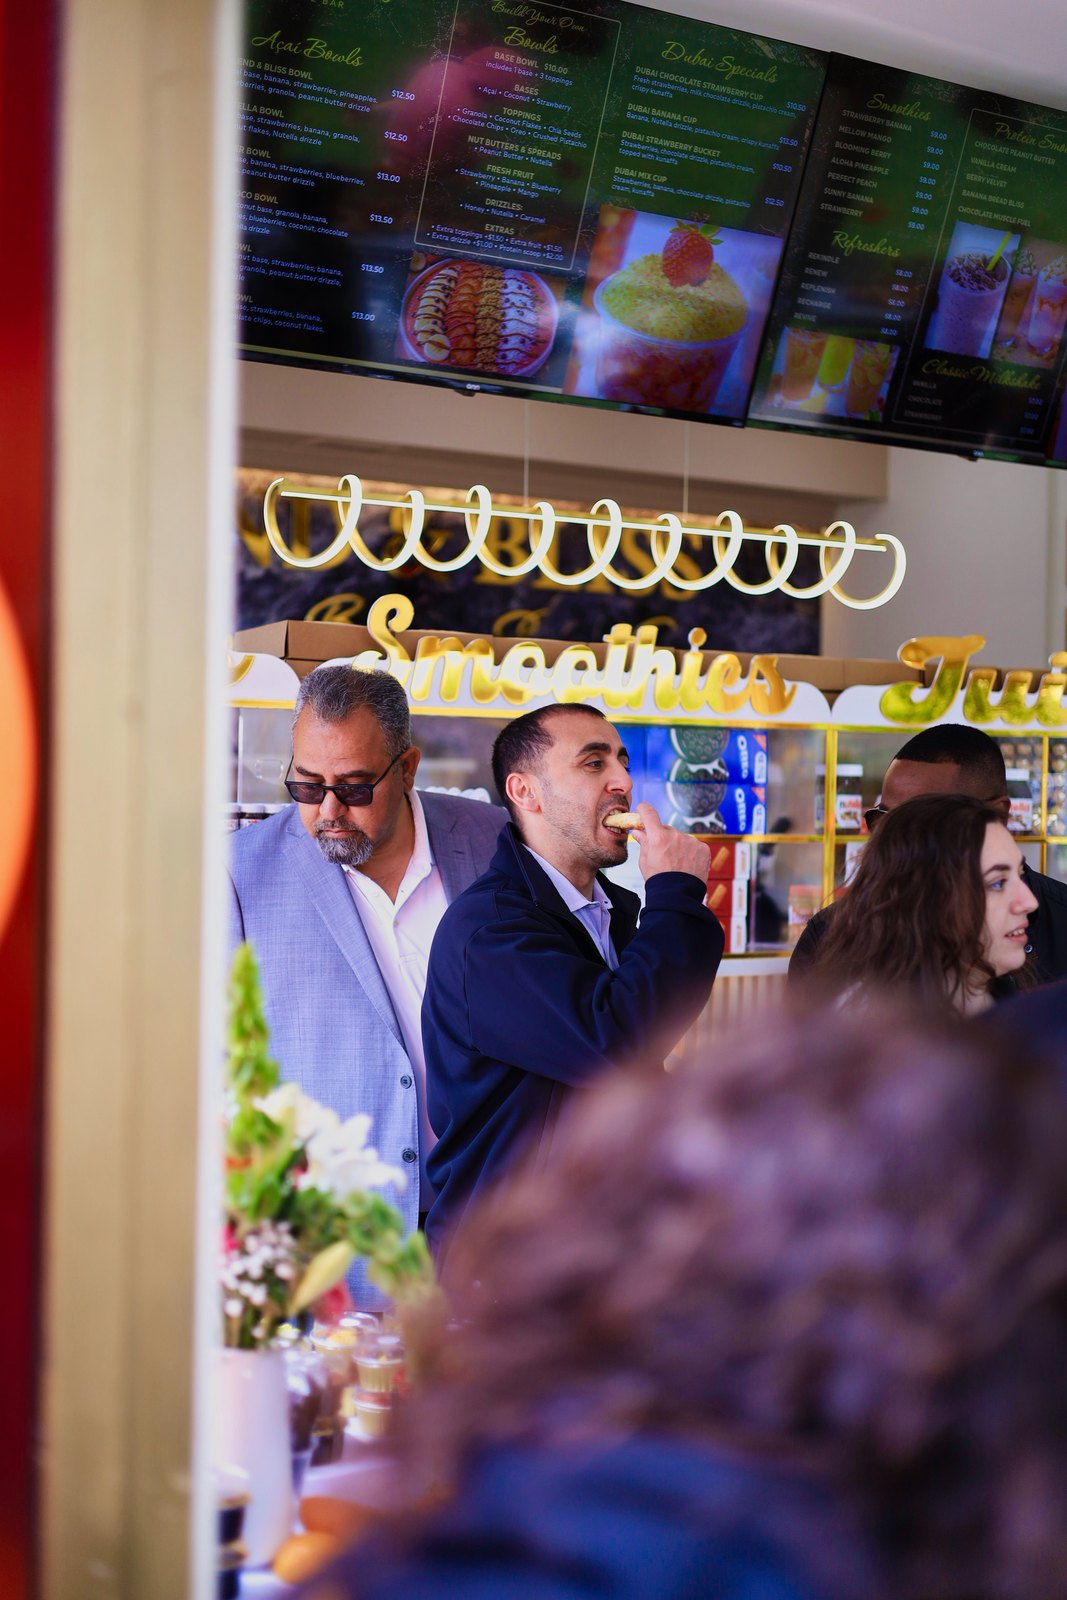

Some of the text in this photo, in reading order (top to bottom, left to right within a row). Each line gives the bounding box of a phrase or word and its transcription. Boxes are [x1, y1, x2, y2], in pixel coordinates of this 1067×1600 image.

[322, 0, 344, 8] BAR
[525, 9, 557, 25] Your
[504, 26, 558, 54] Bowls
[304, 38, 364, 66] Bowls
[495, 52, 568, 74] BASE BOWL $10.00
[661, 41, 778, 83] Dubai Specials
[264, 63, 287, 74] BLISS
[288, 68, 312, 80] BOWL
[486, 61, 512, 72] Includes
[518, 68, 533, 76] base
[545, 74, 573, 86] toppings
[264, 74, 291, 86] banana,
[293, 80, 338, 96] strawberries,
[514, 84, 539, 95] BASES
[636, 66, 658, 77] DUBAI
[660, 72, 701, 87] CHOCOLATE
[702, 82, 749, 98] STRAWBERRY
[268, 87, 415, 112] granola, peanut butter drizzle $12.50
[504, 91, 530, 102] Coconut
[536, 98, 571, 112] Strawberry
[866, 93, 931, 121] Smoothies
[260, 107, 284, 118] BOWL
[503, 107, 541, 121] TOPPINGS
[628, 103, 650, 113] DUBAI
[652, 108, 681, 120] BANANA
[462, 108, 582, 138] Granola Coconut Flakes Chia Seeds
[842, 110, 885, 125] STRAWBERRY
[886, 120, 912, 132] BANANA
[257, 117, 302, 132] strawberries,
[304, 125, 331, 138] banana,
[333, 132, 360, 143] granola,
[384, 130, 408, 142] $12.50
[273, 130, 297, 141] Nutella
[300, 136, 322, 145] drizzle
[452, 115, 587, 148] Chocolate Chips Oreo Crushed Pistachio
[868, 132, 892, 143] MANGO
[246, 147, 271, 158] BOWL
[468, 136, 484, 144] NUT
[485, 139, 519, 152] BUTTERS
[528, 148, 562, 160] SPREADS
[622, 131, 720, 158] DUBAI STRAWBERRY BUCKET
[835, 141, 870, 154] BLOOMING
[871, 150, 891, 159] BERRY
[975, 141, 1055, 165] CHOCOLATE PEANUT BUTTER
[480, 146, 552, 166] Peanut Butter Nutella
[251, 159, 400, 186] banana, strawberries, blueberries, $13.00
[487, 165, 535, 180] FRESH FRUIT
[615, 167, 637, 176] DUBAI
[638, 172, 652, 180] MIX
[855, 162, 890, 175] PINEAPPLE
[996, 164, 1016, 172] CREAM
[268, 172, 290, 182] butter
[292, 177, 315, 187] drizzle
[460, 168, 561, 195] Strawberry Banana Blueberry
[828, 172, 877, 188] PERFECT PEACH
[480, 181, 539, 198] Pineapple Mango
[254, 193, 278, 204] BOWL
[485, 198, 523, 211] DRIZZLES:
[275, 209, 301, 220] granola,
[370, 214, 393, 224] $13.50
[464, 203, 545, 224] Honey Nutella Caramel
[820, 203, 863, 217] STRAWBERRY
[248, 226, 270, 234] drizzle
[288, 223, 316, 232] coconut,
[317, 227, 349, 237] chocolate
[432, 232, 449, 241] Extra
[436, 225, 453, 234] Extra
[455, 229, 483, 239] toppings
[485, 224, 515, 235] EXTRAS
[832, 231, 900, 257] Refreshers
[360, 263, 384, 273] $13.50
[352, 312, 375, 321] $13.00
[352, 593, 796, 714] Smoothies
